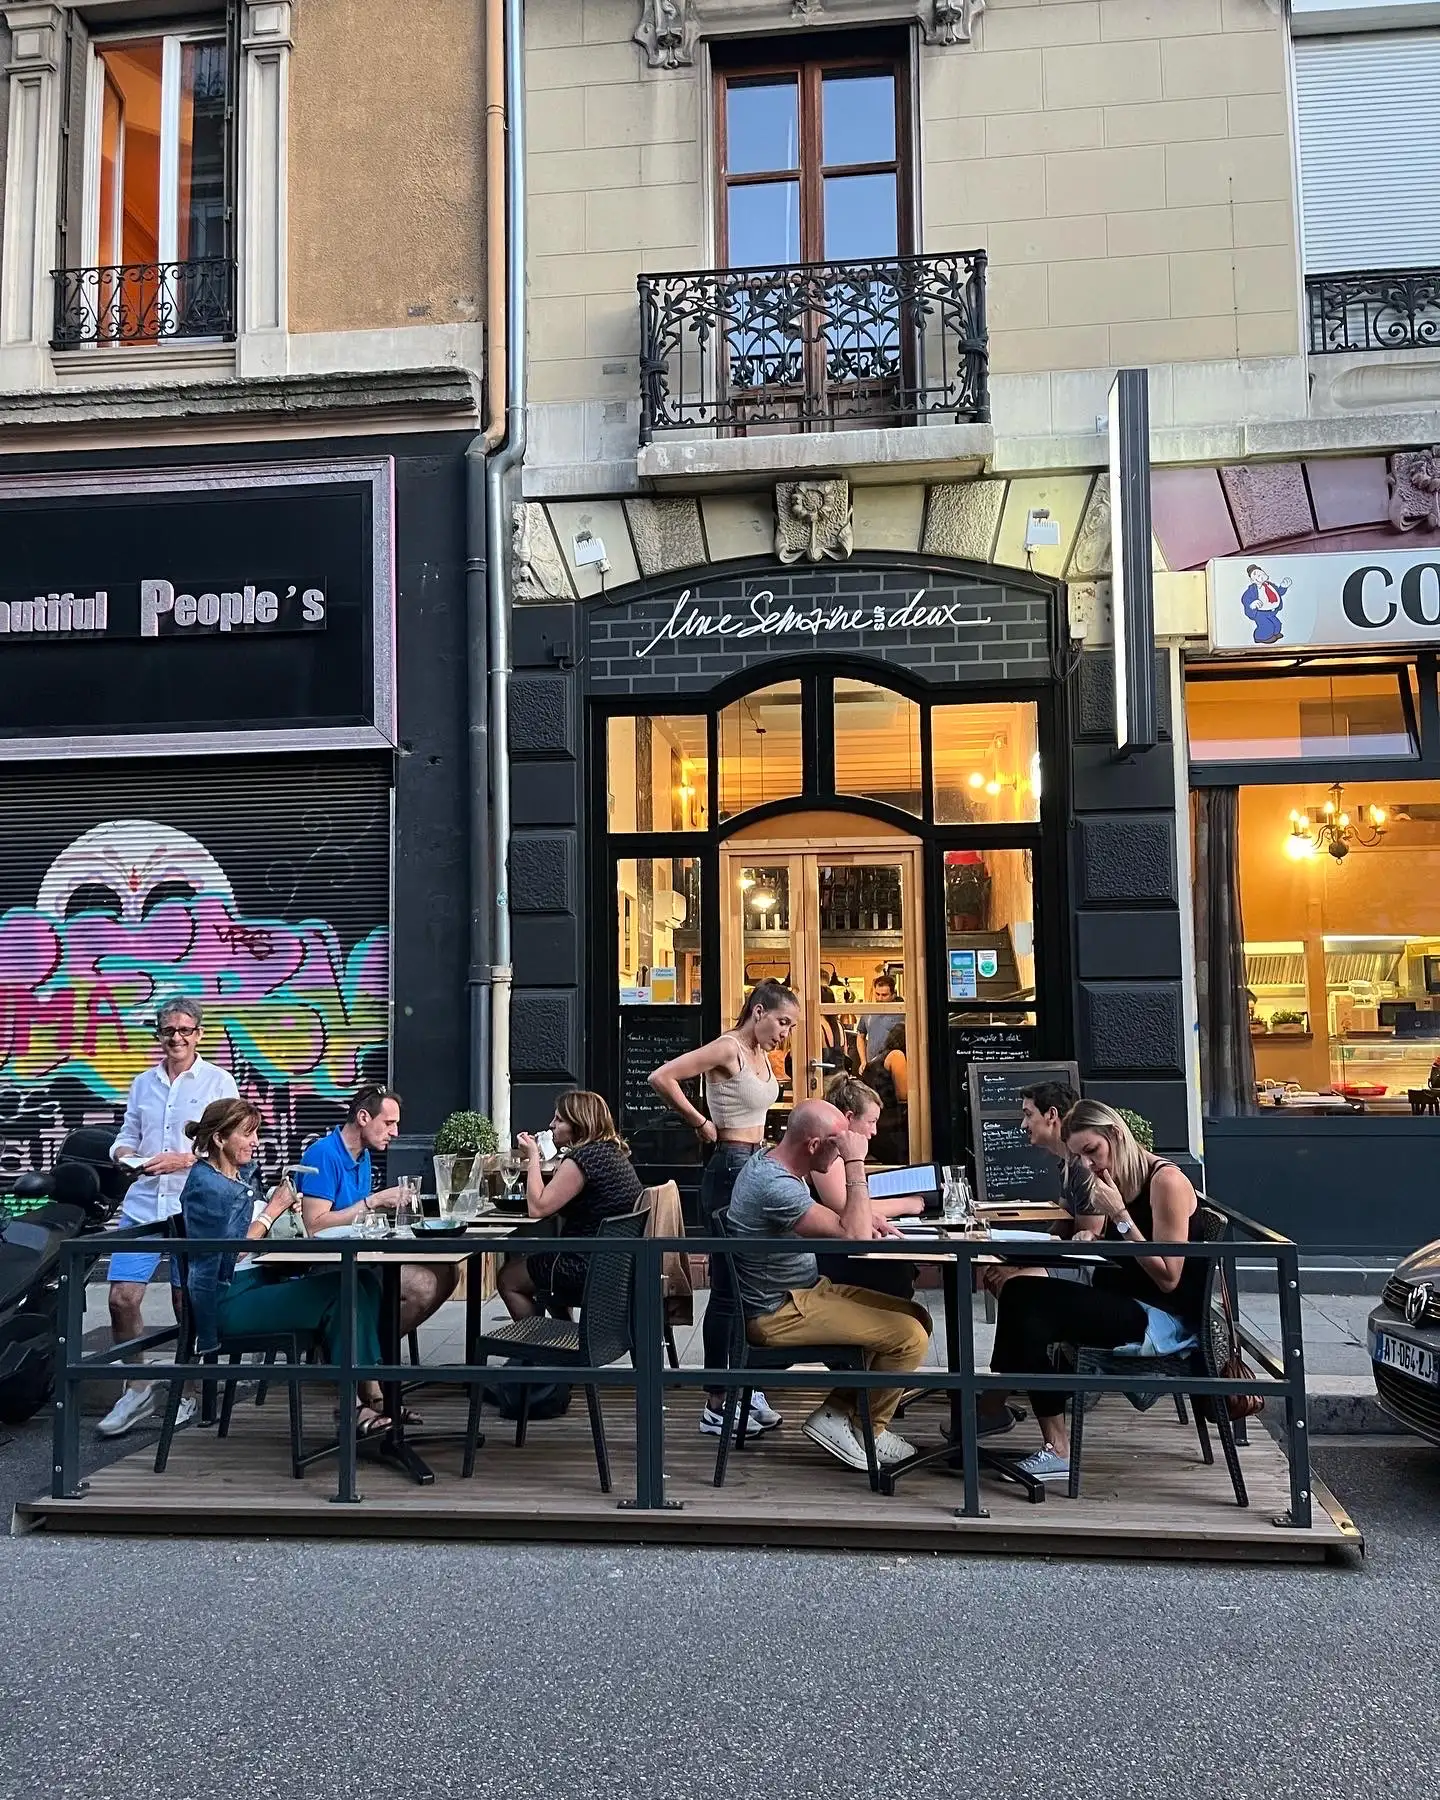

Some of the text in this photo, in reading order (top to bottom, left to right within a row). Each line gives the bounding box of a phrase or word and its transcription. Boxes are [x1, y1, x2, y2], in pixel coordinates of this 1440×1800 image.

[140, 579, 324, 637] People's
[635, 588, 991, 658] Une Semaine SUR deux
[1342, 562, 1440, 629] CO
